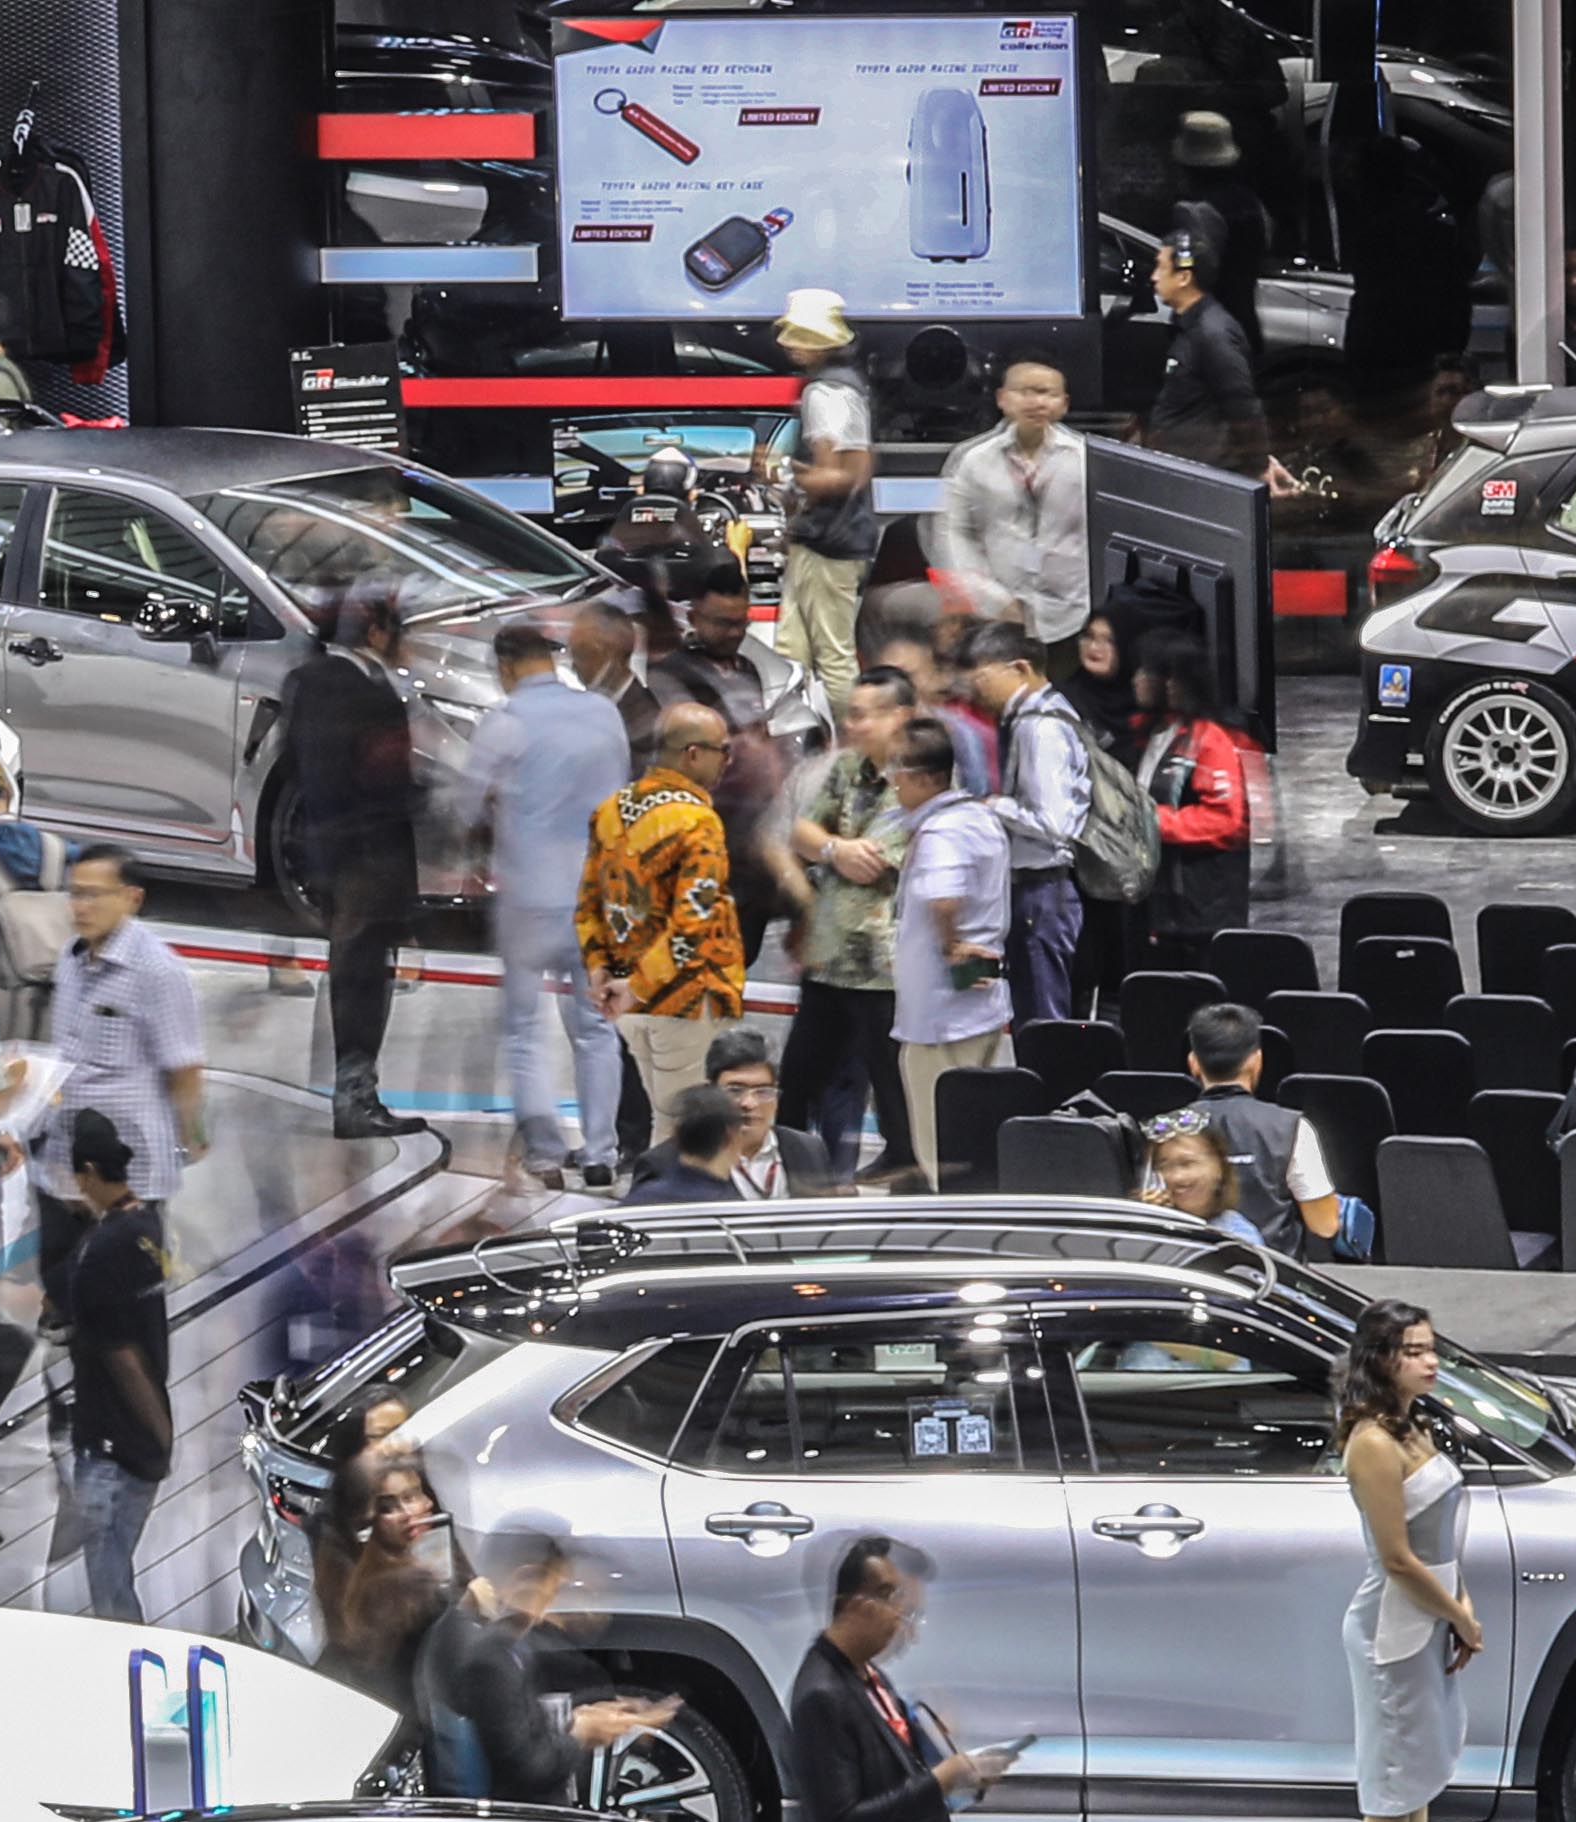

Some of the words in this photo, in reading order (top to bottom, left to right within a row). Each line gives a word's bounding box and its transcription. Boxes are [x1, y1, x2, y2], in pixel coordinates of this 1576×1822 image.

[1000, 42, 1068, 50] collection
[586, 65, 620, 74] TOYOTA
[625, 65, 655, 74] GAZOO
[661, 65, 696, 74] RACING
[702, 65, 720, 74] RED
[724, 65, 773, 74] KEYCHAIN
[856, 64, 890, 73] TOYOTA
[896, 64, 925, 73] GAZOO
[931, 64, 966, 73] RACING
[972, 64, 1019, 73] SUITCASE
[601, 182, 635, 190] TOYOTA
[641, 182, 670, 190] GAZOO
[676, 182, 710, 190] RACING
[716, 182, 734, 190] KEY
[740, 182, 763, 190] CASE
[1483, 481, 1517, 498] 3M
